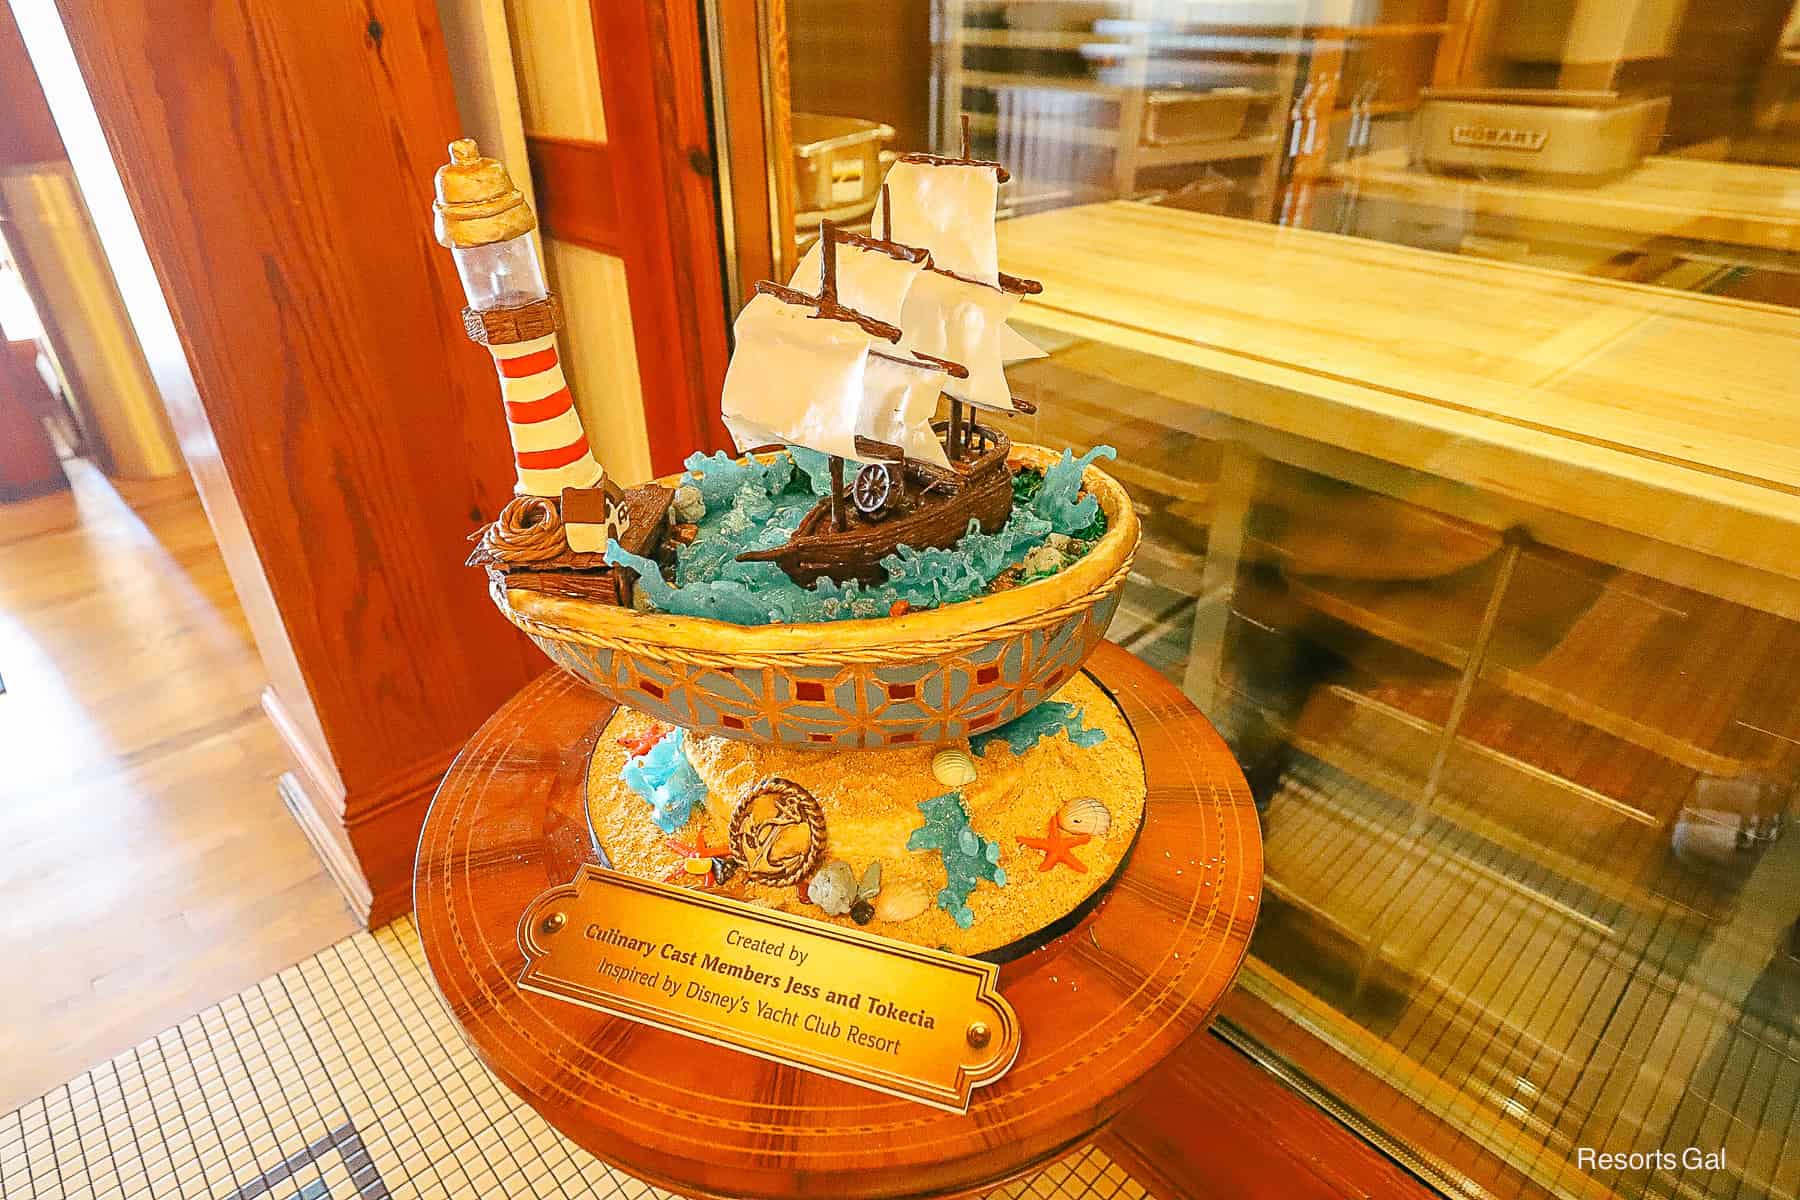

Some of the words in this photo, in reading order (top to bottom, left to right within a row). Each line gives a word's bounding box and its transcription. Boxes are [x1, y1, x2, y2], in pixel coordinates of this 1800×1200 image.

[584, 923, 657, 957] Culinary
[660, 943, 698, 967] Cast
[700, 954, 781, 989] Members
[783, 976, 820, 999] Jess
[825, 987, 861, 1011] and
[867, 997, 936, 1030] Tokecia
[726, 929, 785, 958] Created
[789, 944, 809, 966] by
[598, 957, 659, 991] Inspired
[662, 971, 682, 995] by
[685, 981, 750, 1015] Disney's
[756, 1001, 799, 1028] Yacht
[804, 1014, 841, 1039] Club
[847, 1026, 901, 1056] Resort
